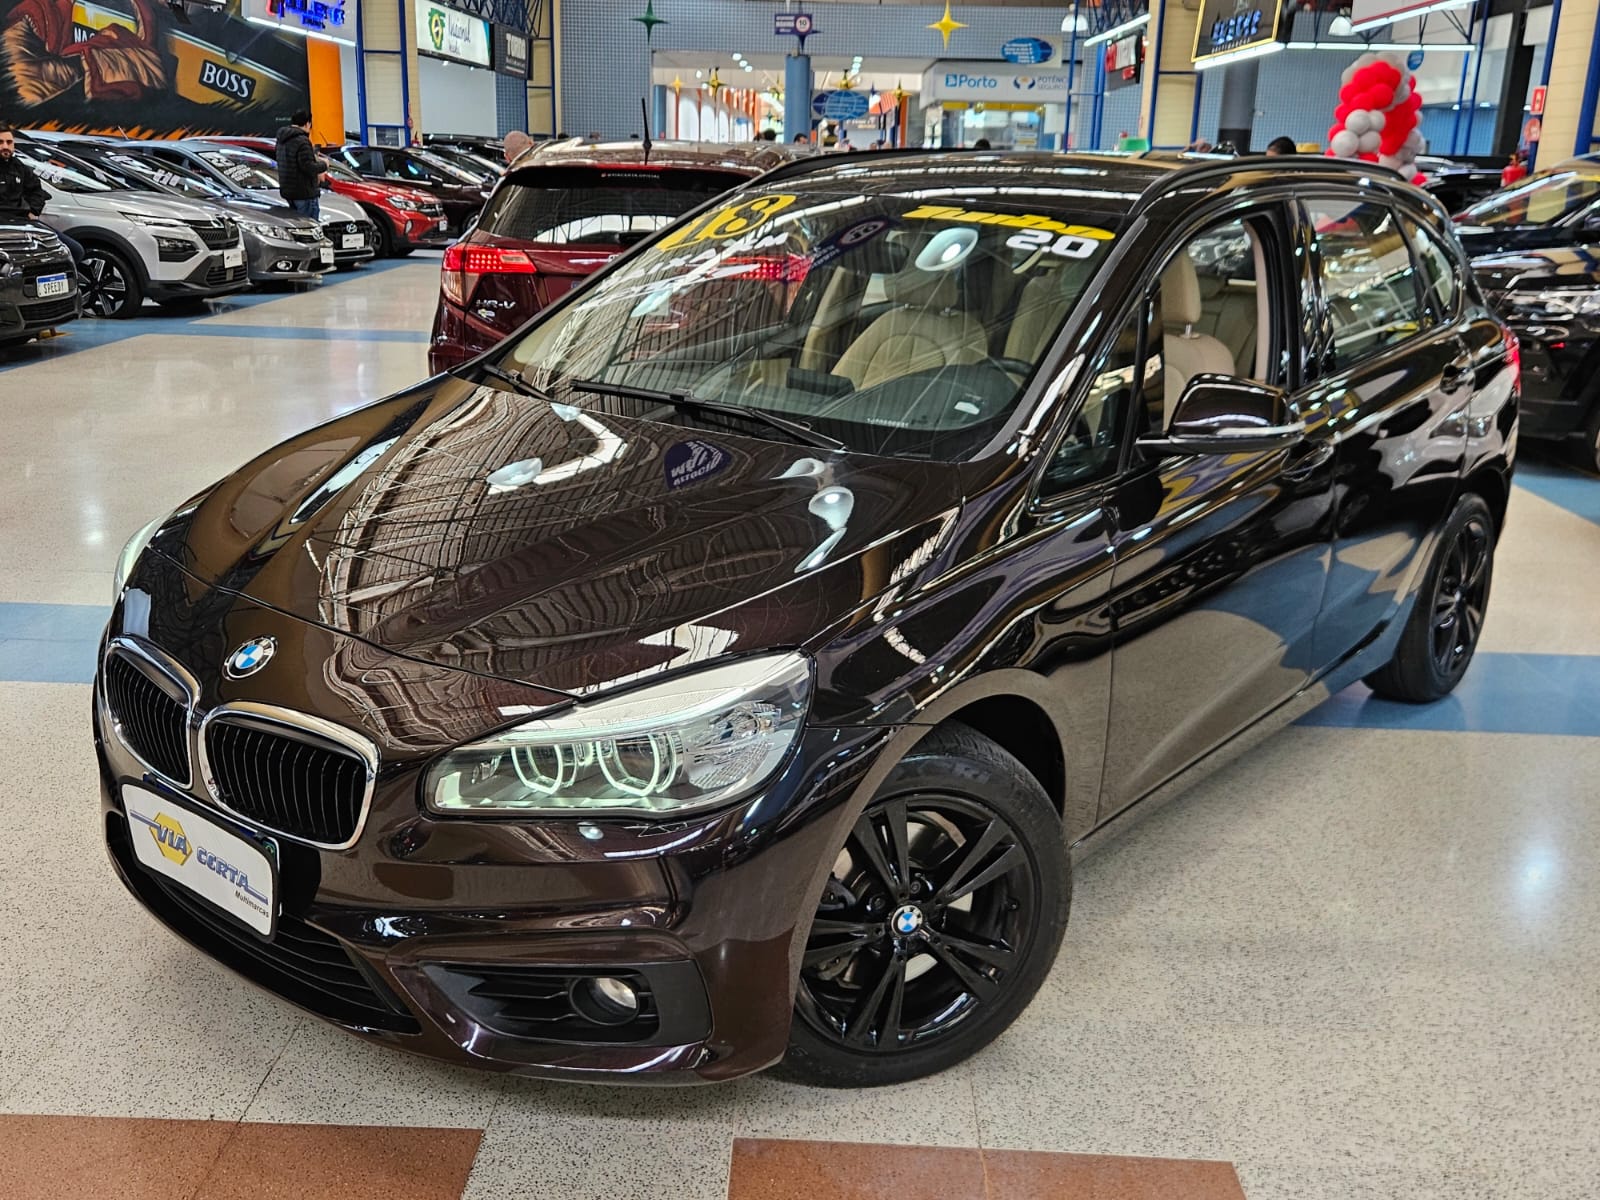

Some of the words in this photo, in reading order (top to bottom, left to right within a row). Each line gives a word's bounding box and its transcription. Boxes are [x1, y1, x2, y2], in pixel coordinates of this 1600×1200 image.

[203, 62, 252, 98] BOSS
[958, 74, 998, 89] Porto
[1005, 228, 1100, 259] 2.0
[475, 299, 516, 309] HR-V
[156, 823, 188, 856] VIA
[196, 846, 250, 893] CERTA
[234, 889, 270, 919] Multimarcas
